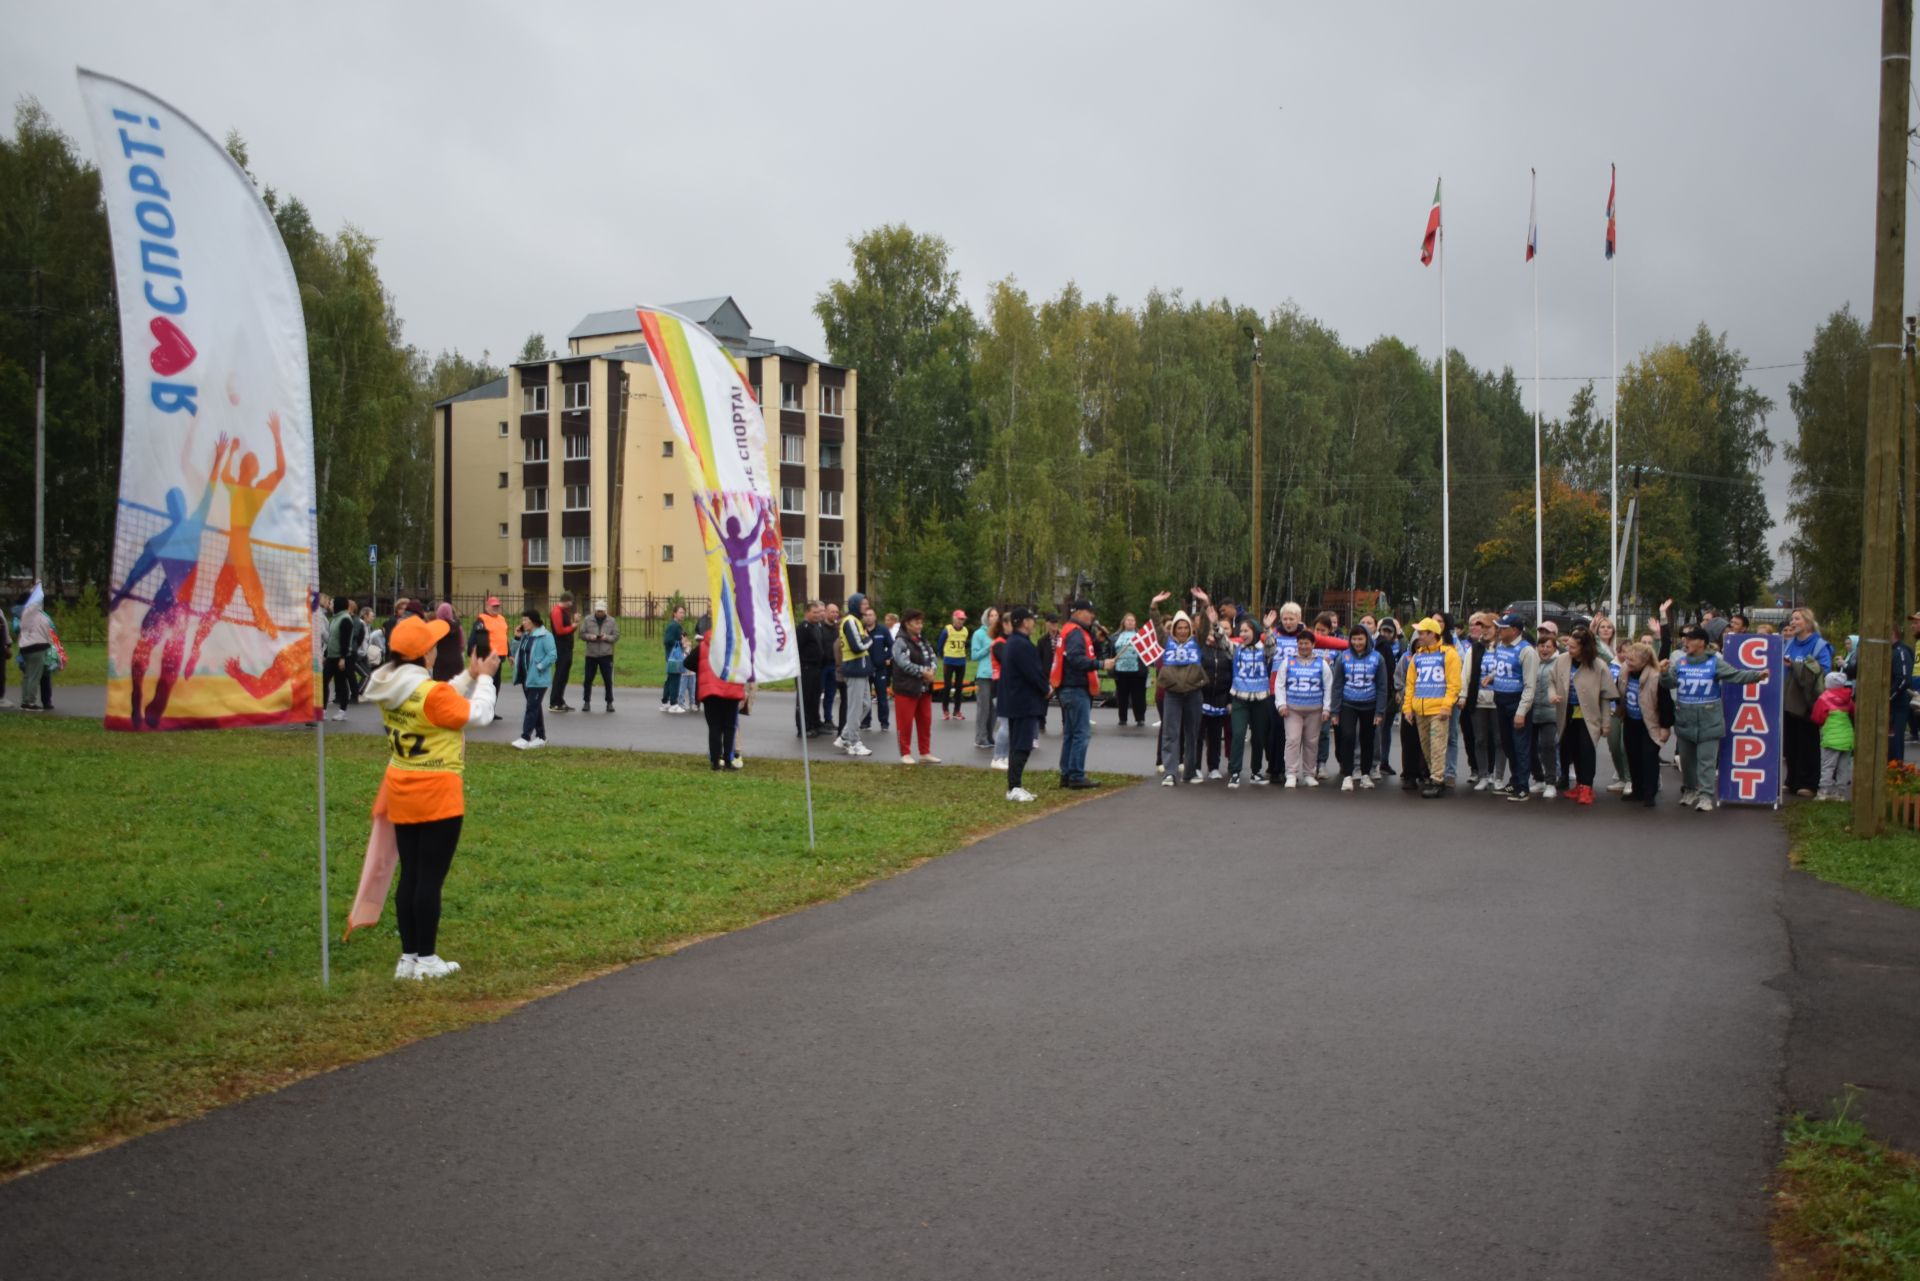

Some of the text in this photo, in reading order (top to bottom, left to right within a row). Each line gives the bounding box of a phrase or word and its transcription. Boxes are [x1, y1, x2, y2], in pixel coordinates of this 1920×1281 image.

[112, 107, 199, 419] Я СПОРТ!
[731, 385, 750, 461] СПОРТА!
[1274, 647, 1298, 660] 28
[1287, 676, 1321, 692] 252
[1345, 673, 1375, 687] 253
[1678, 678, 1714, 695] 277
[1731, 637, 1769, 799] СТАРТ
